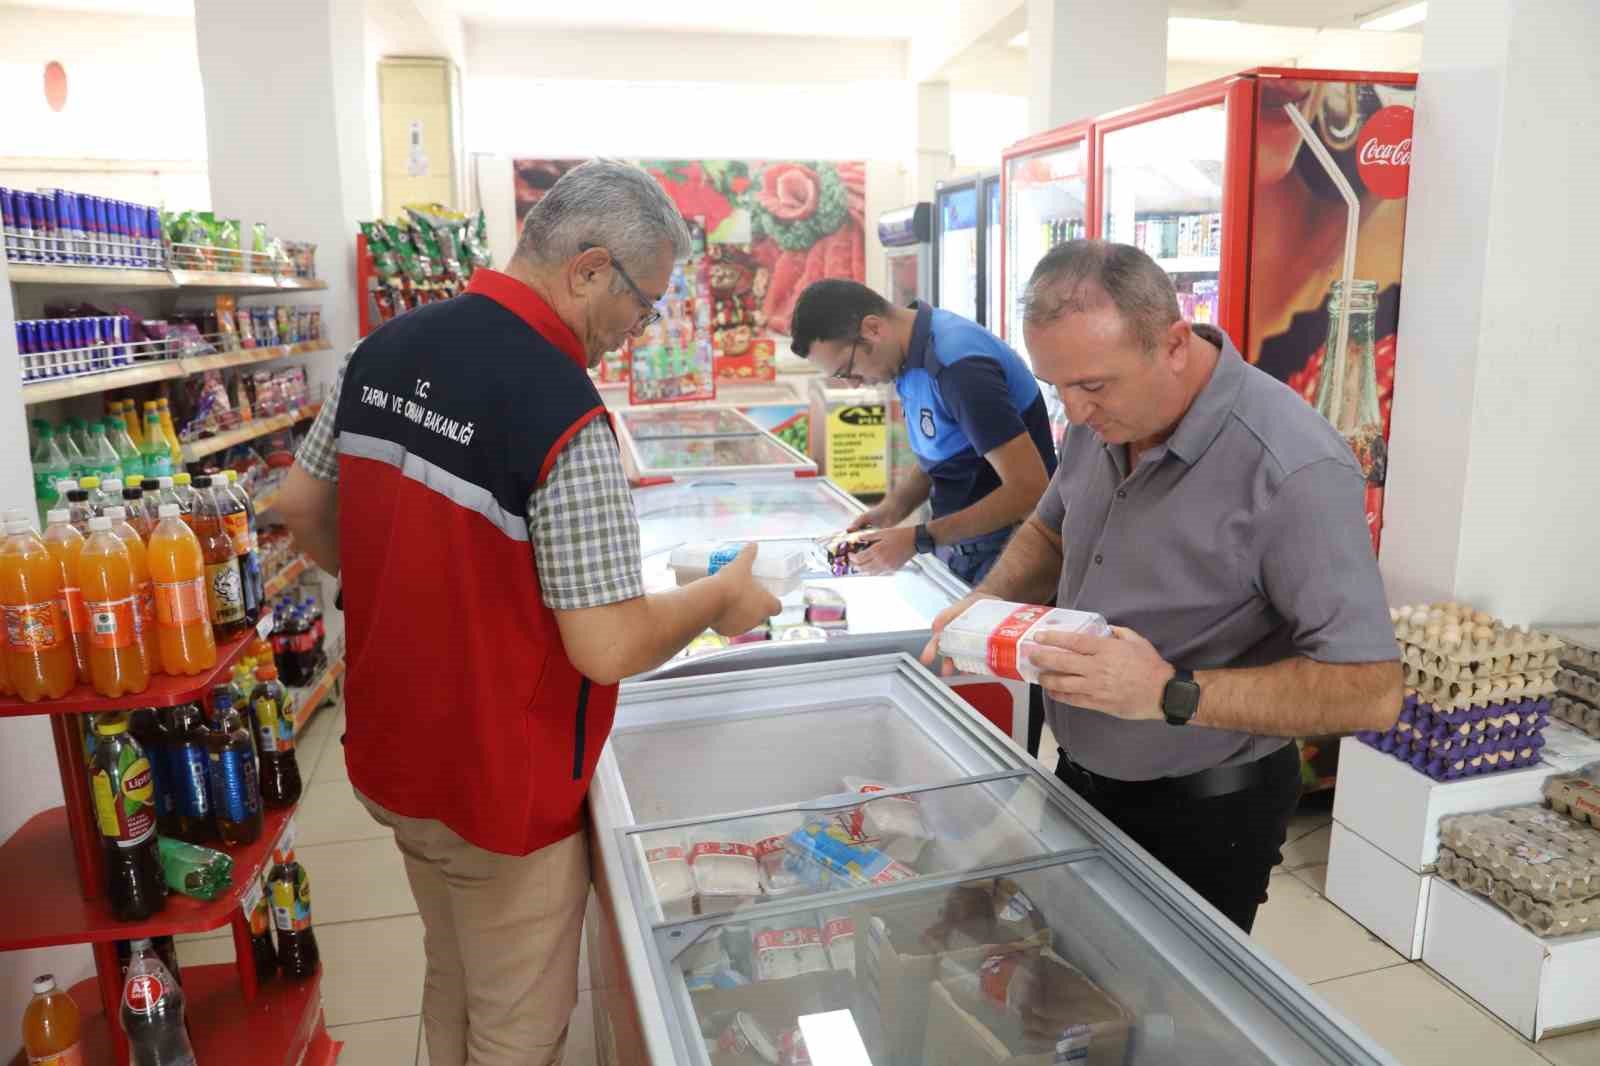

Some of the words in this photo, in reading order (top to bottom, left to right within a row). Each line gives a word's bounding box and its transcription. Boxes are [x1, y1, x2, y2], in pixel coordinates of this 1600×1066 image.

[1360, 137, 1412, 166] Coca-Co
[361, 386, 389, 409] TARIM
[392, 394, 404, 414] VE
[423, 410, 474, 446] BAKANLIĞI
[127, 772, 151, 789] Lipt
